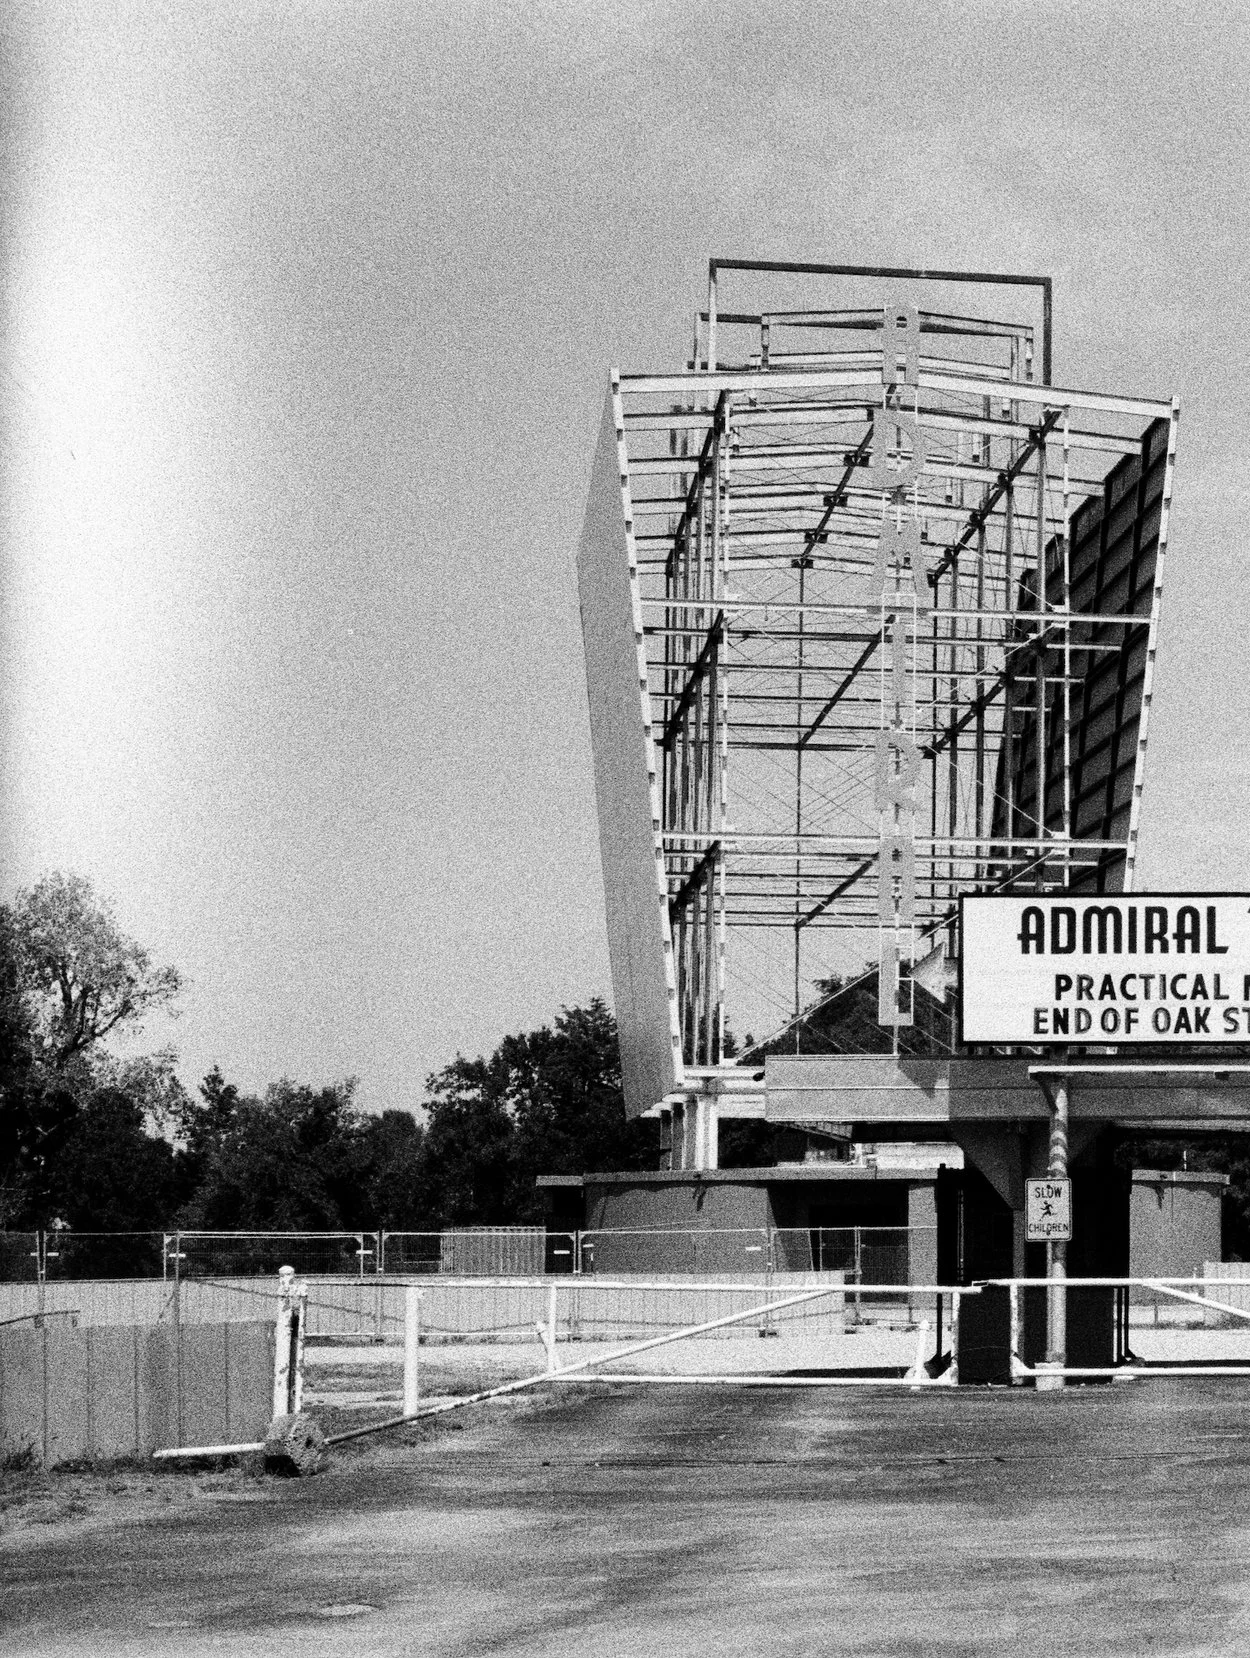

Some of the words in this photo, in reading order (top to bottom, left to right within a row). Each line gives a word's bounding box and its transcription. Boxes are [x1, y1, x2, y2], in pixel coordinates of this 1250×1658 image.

[1017, 905, 1229, 954] ADMIRAL
[1054, 973, 1230, 1001] PRACTICAL
[1033, 1007, 1092, 1034] END
[1100, 1007, 1139, 1034] OF
[1151, 1007, 1211, 1034] OAK
[1034, 1187, 1062, 1198] SLOW
[1029, 1223, 1069, 1232] CHILDREN
